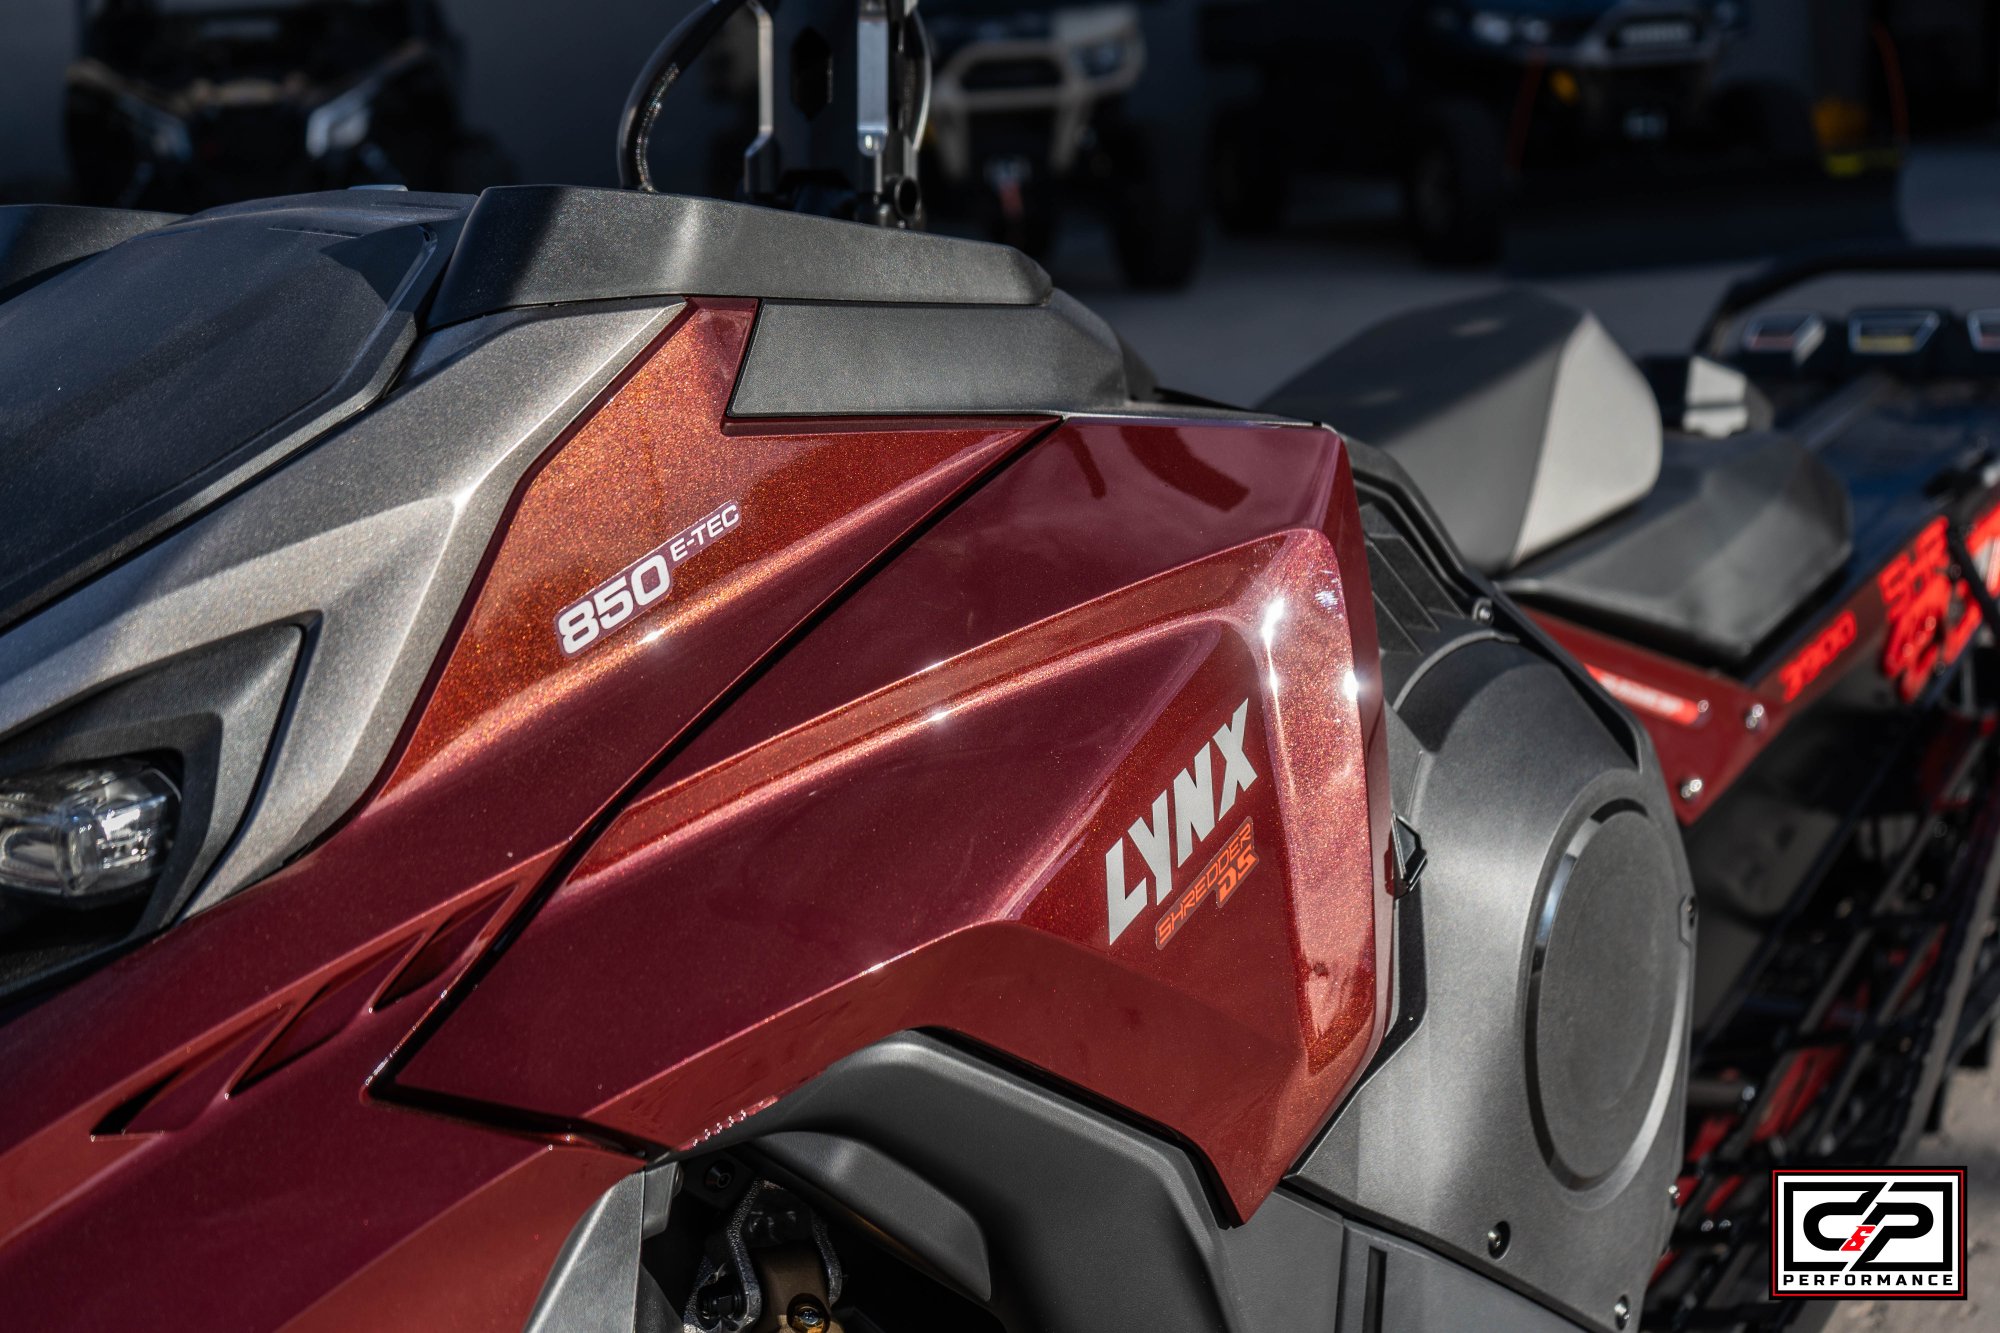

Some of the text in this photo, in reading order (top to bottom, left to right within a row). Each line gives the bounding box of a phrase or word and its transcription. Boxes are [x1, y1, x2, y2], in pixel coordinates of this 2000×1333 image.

[558, 504, 740, 654] 850 E-TEC
[1105, 697, 1259, 946] LYNX
[1157, 823, 1253, 945] SHREDDER
[1217, 847, 1257, 904] DS
